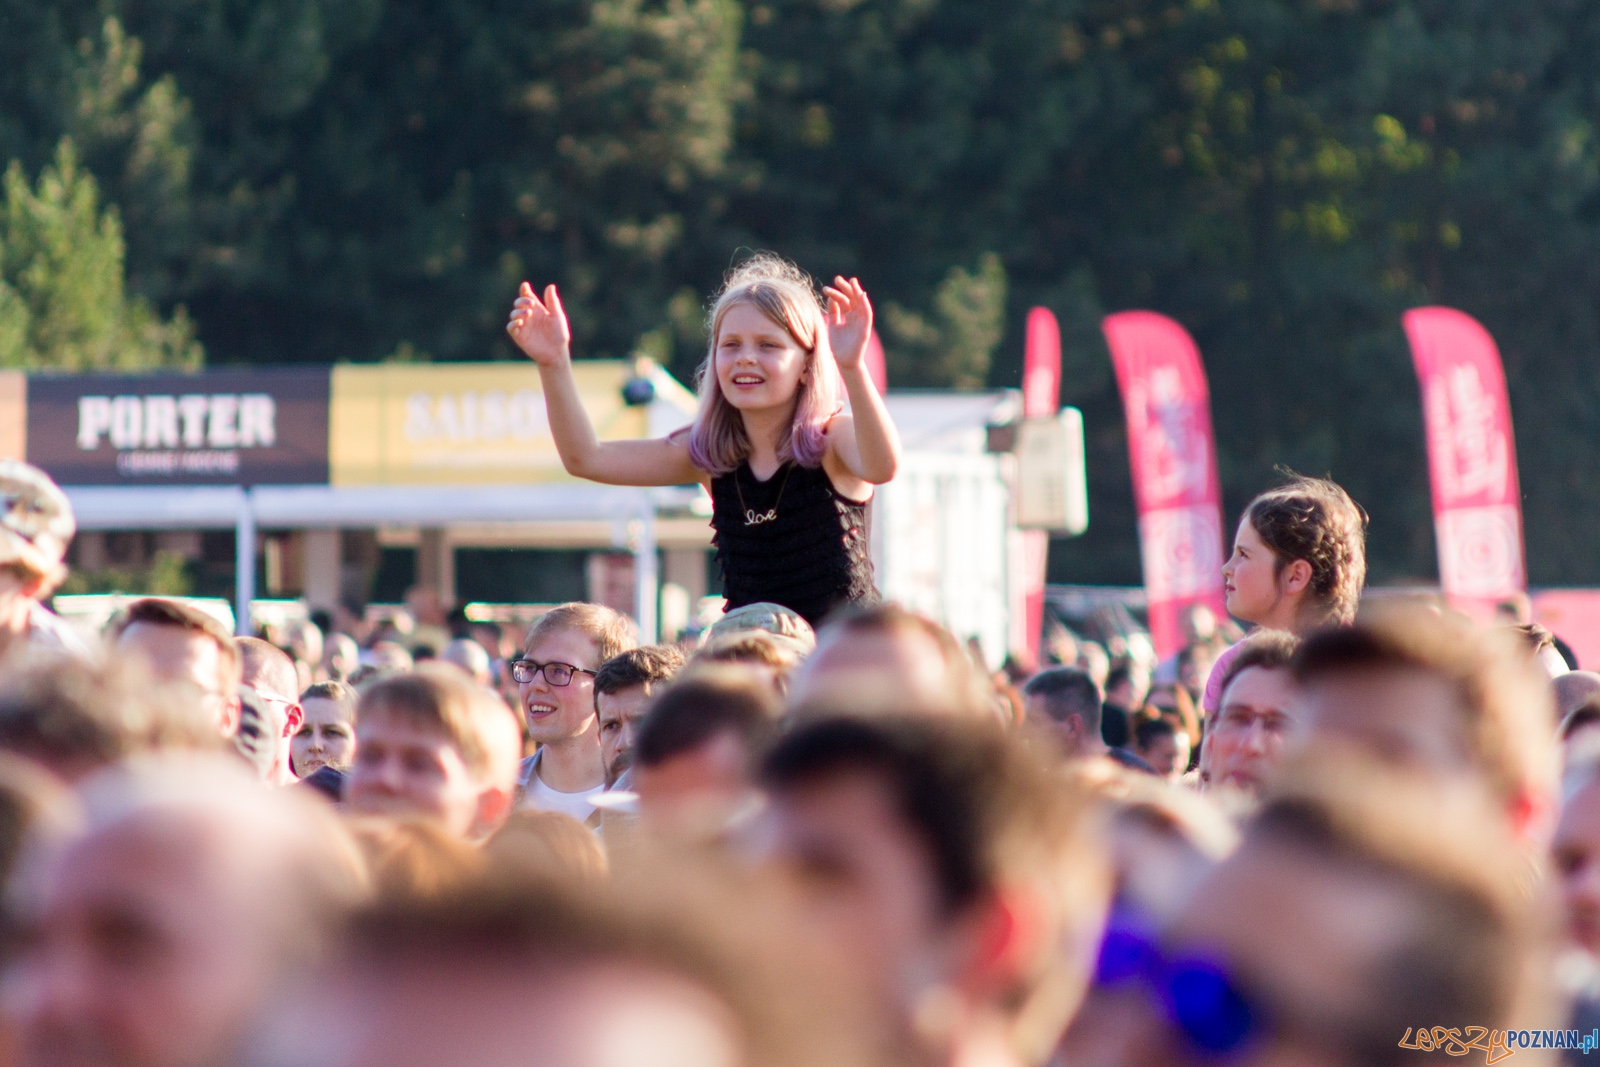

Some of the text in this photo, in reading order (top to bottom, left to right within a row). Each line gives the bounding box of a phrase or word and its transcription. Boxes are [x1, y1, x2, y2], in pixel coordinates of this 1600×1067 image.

[77, 394, 276, 449] PORTER
[405, 391, 549, 442] SAISO
[744, 509, 777, 525] love
